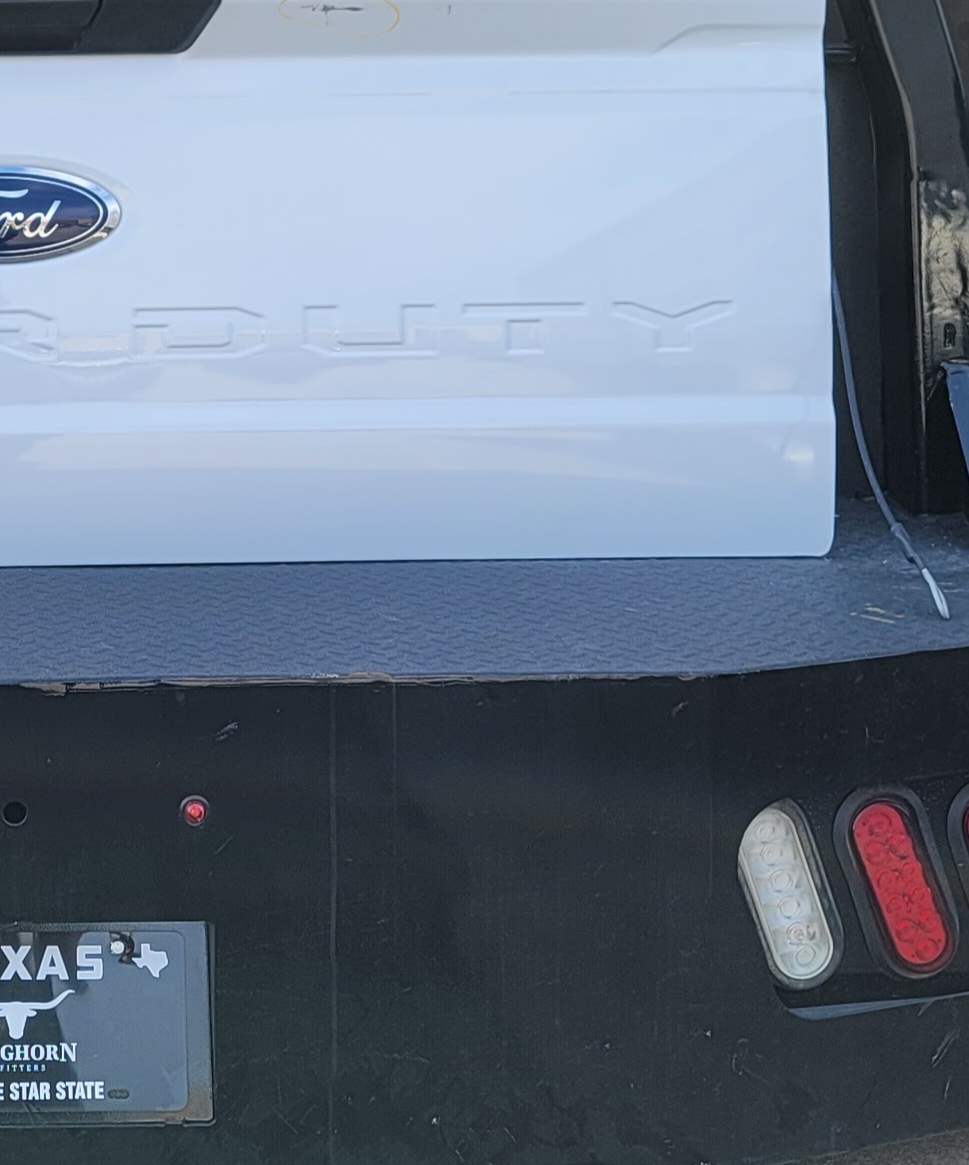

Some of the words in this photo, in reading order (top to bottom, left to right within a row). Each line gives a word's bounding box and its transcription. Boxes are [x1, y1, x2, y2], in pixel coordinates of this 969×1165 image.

[132, 298, 734, 363] DUTY
[9, 1082, 51, 1102] STAR
[56, 1081, 105, 1101] STATE
